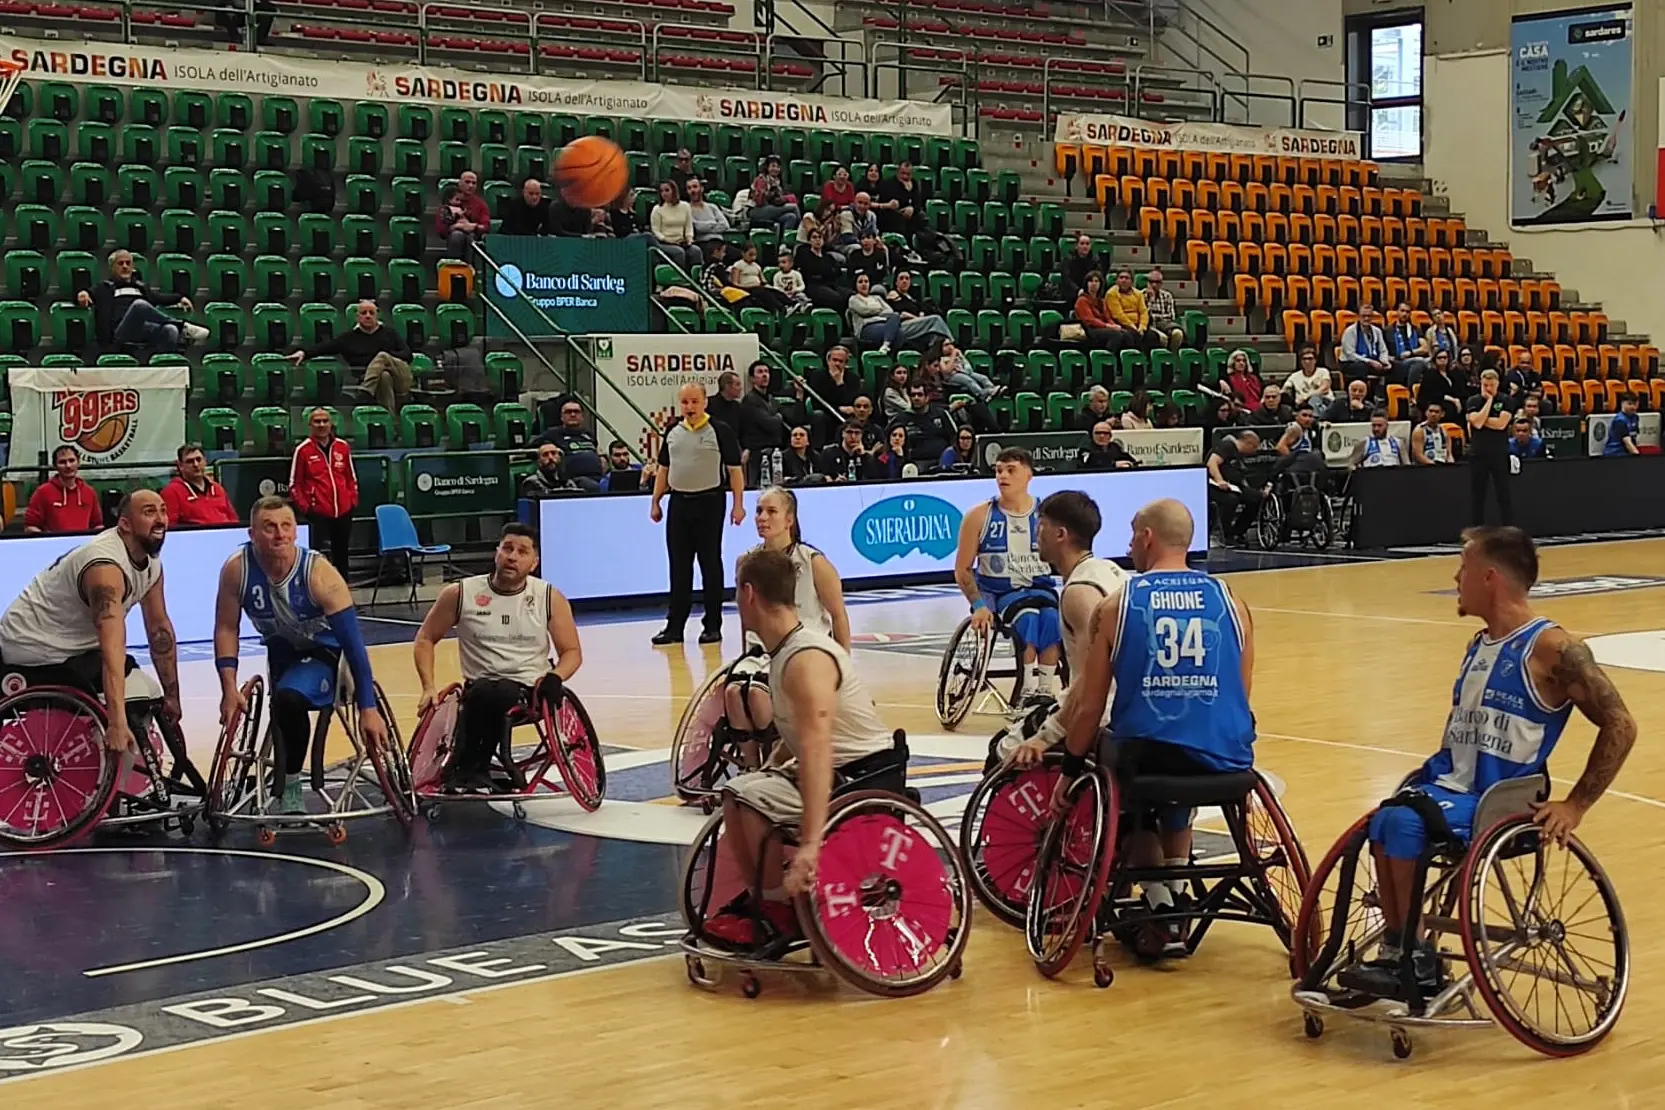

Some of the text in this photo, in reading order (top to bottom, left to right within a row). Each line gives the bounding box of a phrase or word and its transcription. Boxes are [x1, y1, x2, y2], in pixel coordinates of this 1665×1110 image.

[1585, 26, 1622, 38] sardares
[1519, 45, 1549, 59] CASA
[11, 48, 319, 88] SARDEGNA ISOLA dell'Artigianato
[395, 76, 648, 111] SARDEGNA ISOLA dell'Artigianato
[720, 99, 828, 124] SARDEGNA
[831, 110, 862, 123] ISOLA
[1086, 122, 1172, 146] SARDEGNA
[1281, 135, 1357, 156] SARDEGNA
[525, 273, 626, 295] Banco di Sardeg
[556, 296, 575, 307] BPER
[575, 297, 598, 308] Banca
[626, 353, 735, 373] SARDEGNA
[627, 375, 659, 387] ISOLA
[1161, 442, 1200, 456] Sardegna
[465, 475, 499, 486] Sardegna
[866, 514, 953, 545] SMERALDINA
[989, 520, 1006, 539] 27
[251, 584, 265, 610] 3
[1150, 590, 1205, 610] GHIONE
[501, 614, 510, 625] 10
[1155, 616, 1206, 668] 34
[1143, 675, 1218, 687] SARDEGNA
[1493, 713, 1511, 732] di
[160, 951, 548, 1029] BLUE
